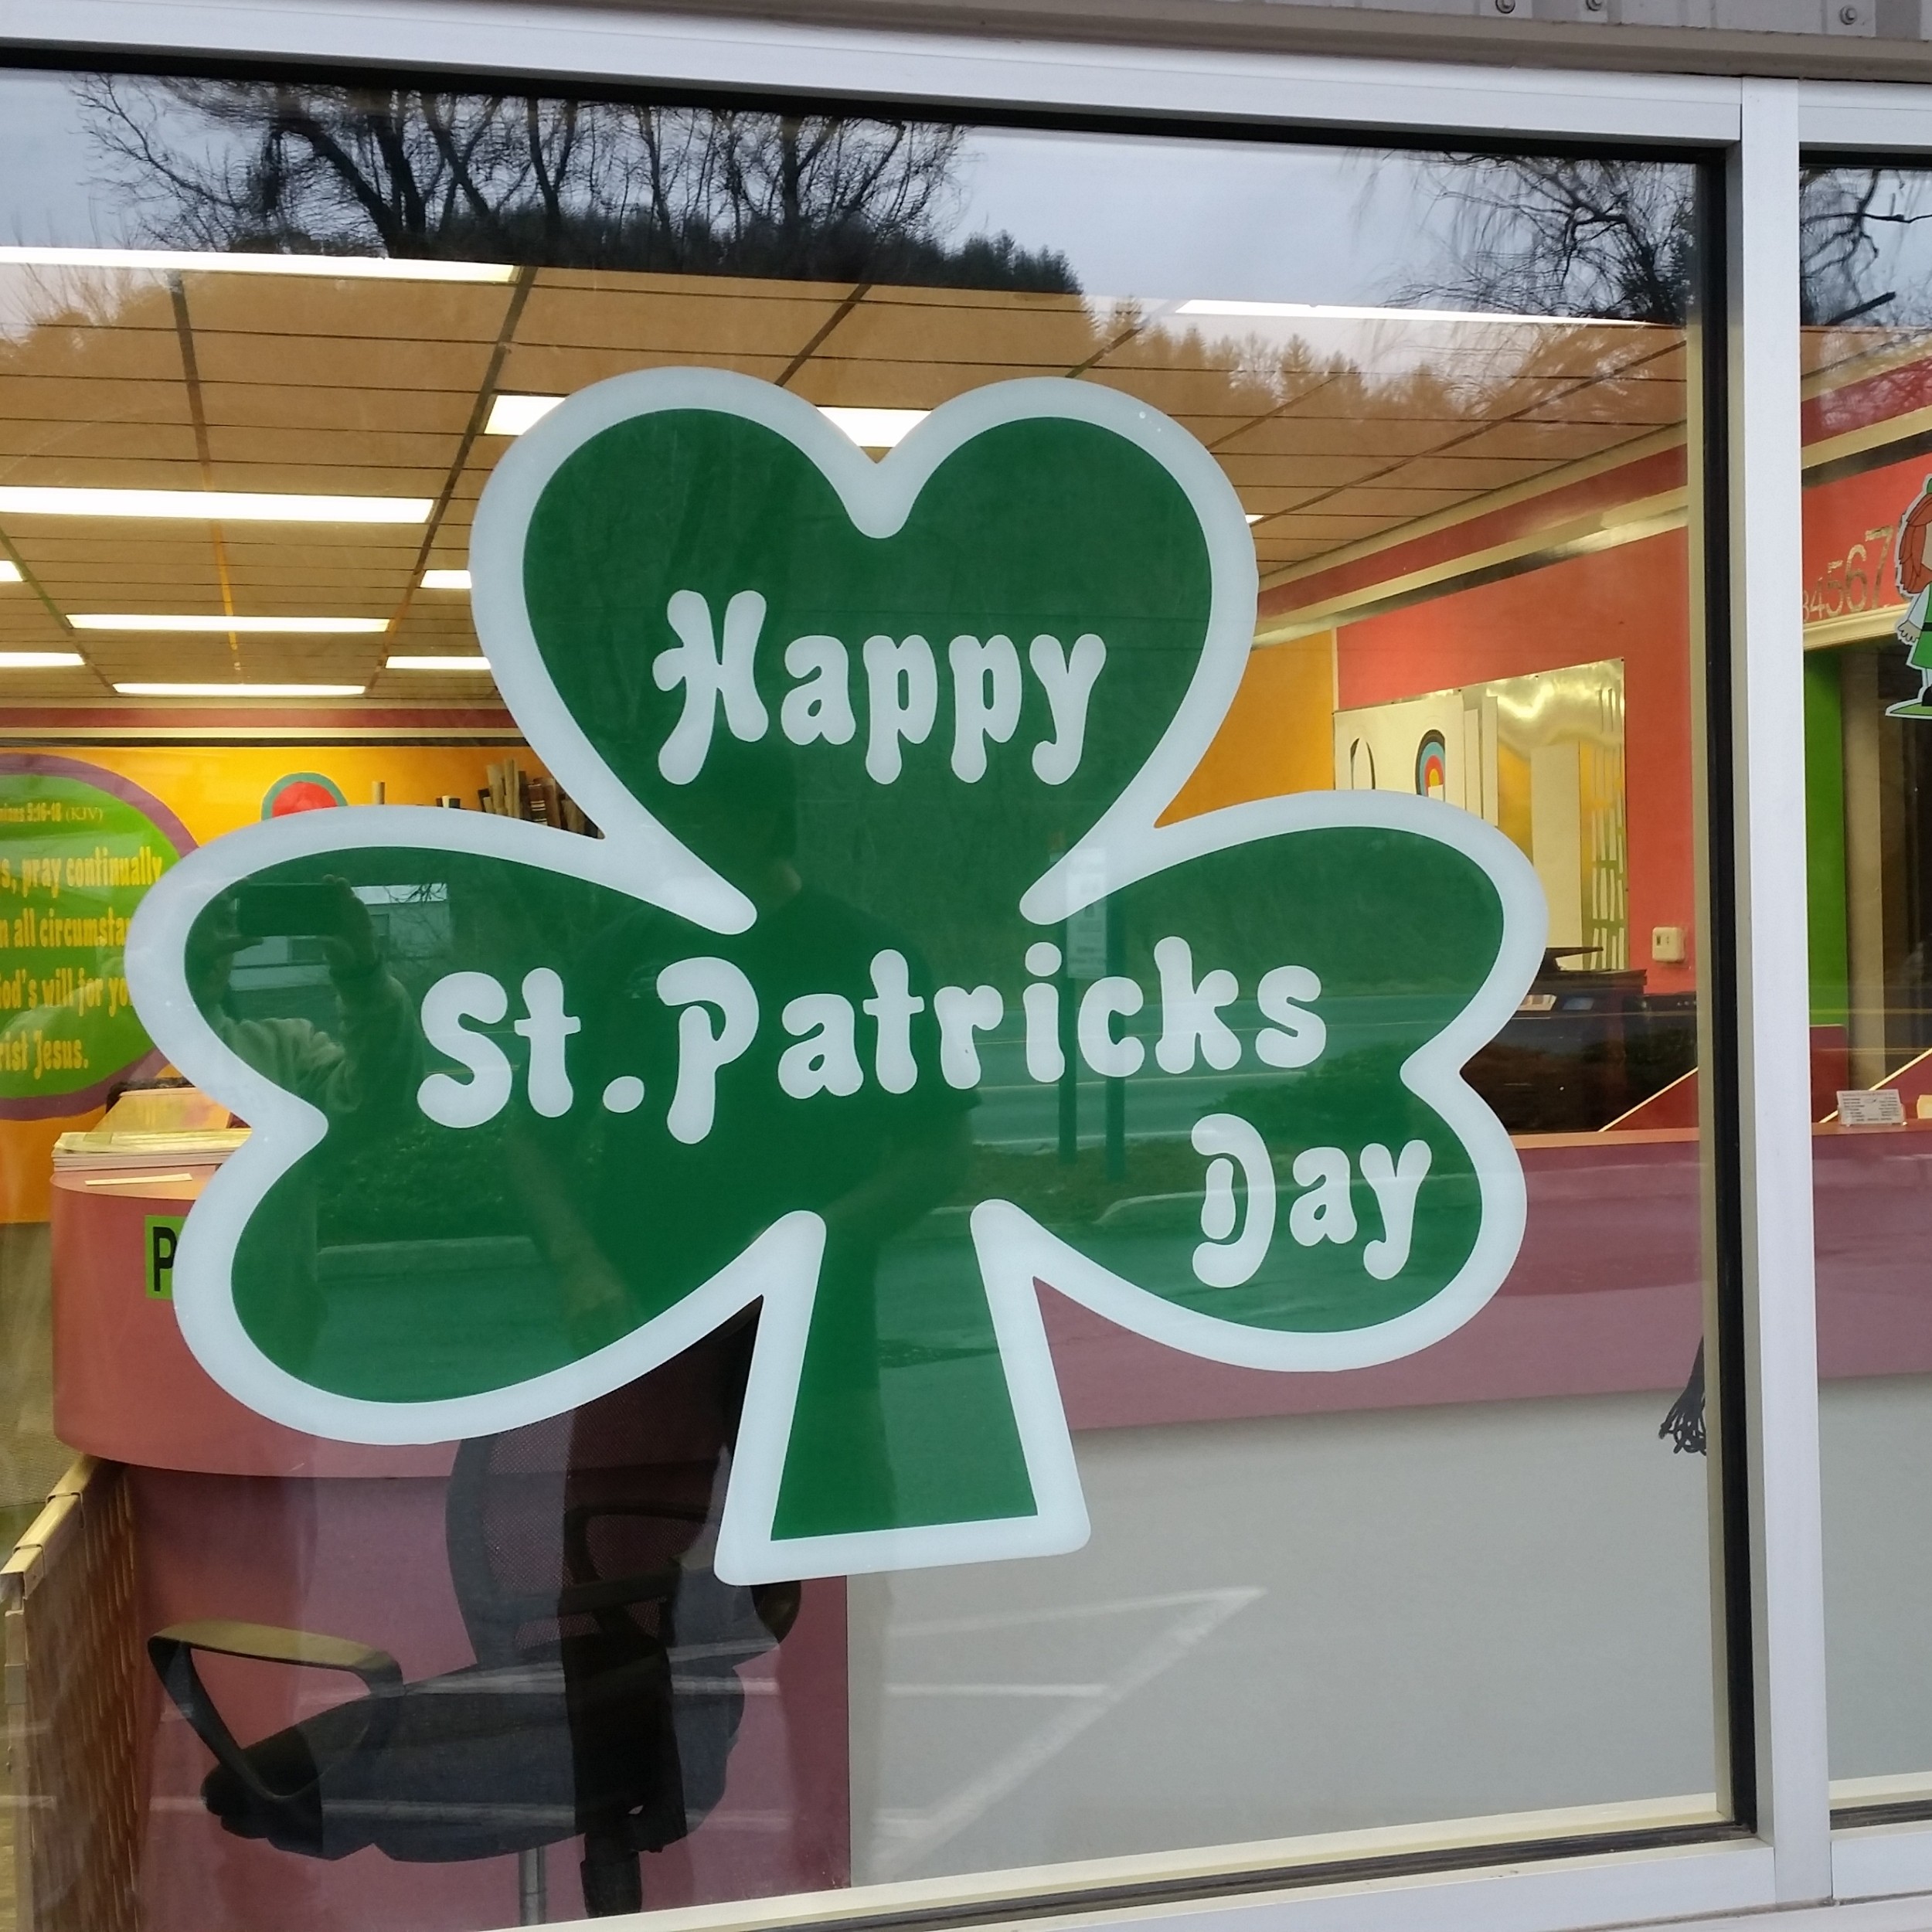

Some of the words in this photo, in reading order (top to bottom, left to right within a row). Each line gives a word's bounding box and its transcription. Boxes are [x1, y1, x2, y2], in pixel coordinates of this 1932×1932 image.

[653, 590, 1106, 784] Happy
[66, 807, 104, 823] (KJV)
[22, 858, 61, 898] pray
[66, 846, 162, 887] continually
[14, 907, 36, 947] all
[0, 968, 37, 1009] od's
[42, 968, 73, 1008] will
[78, 968, 104, 1017] for
[33, 1029, 89, 1080] Jesus.
[1192, 1114, 1431, 1287] Day
